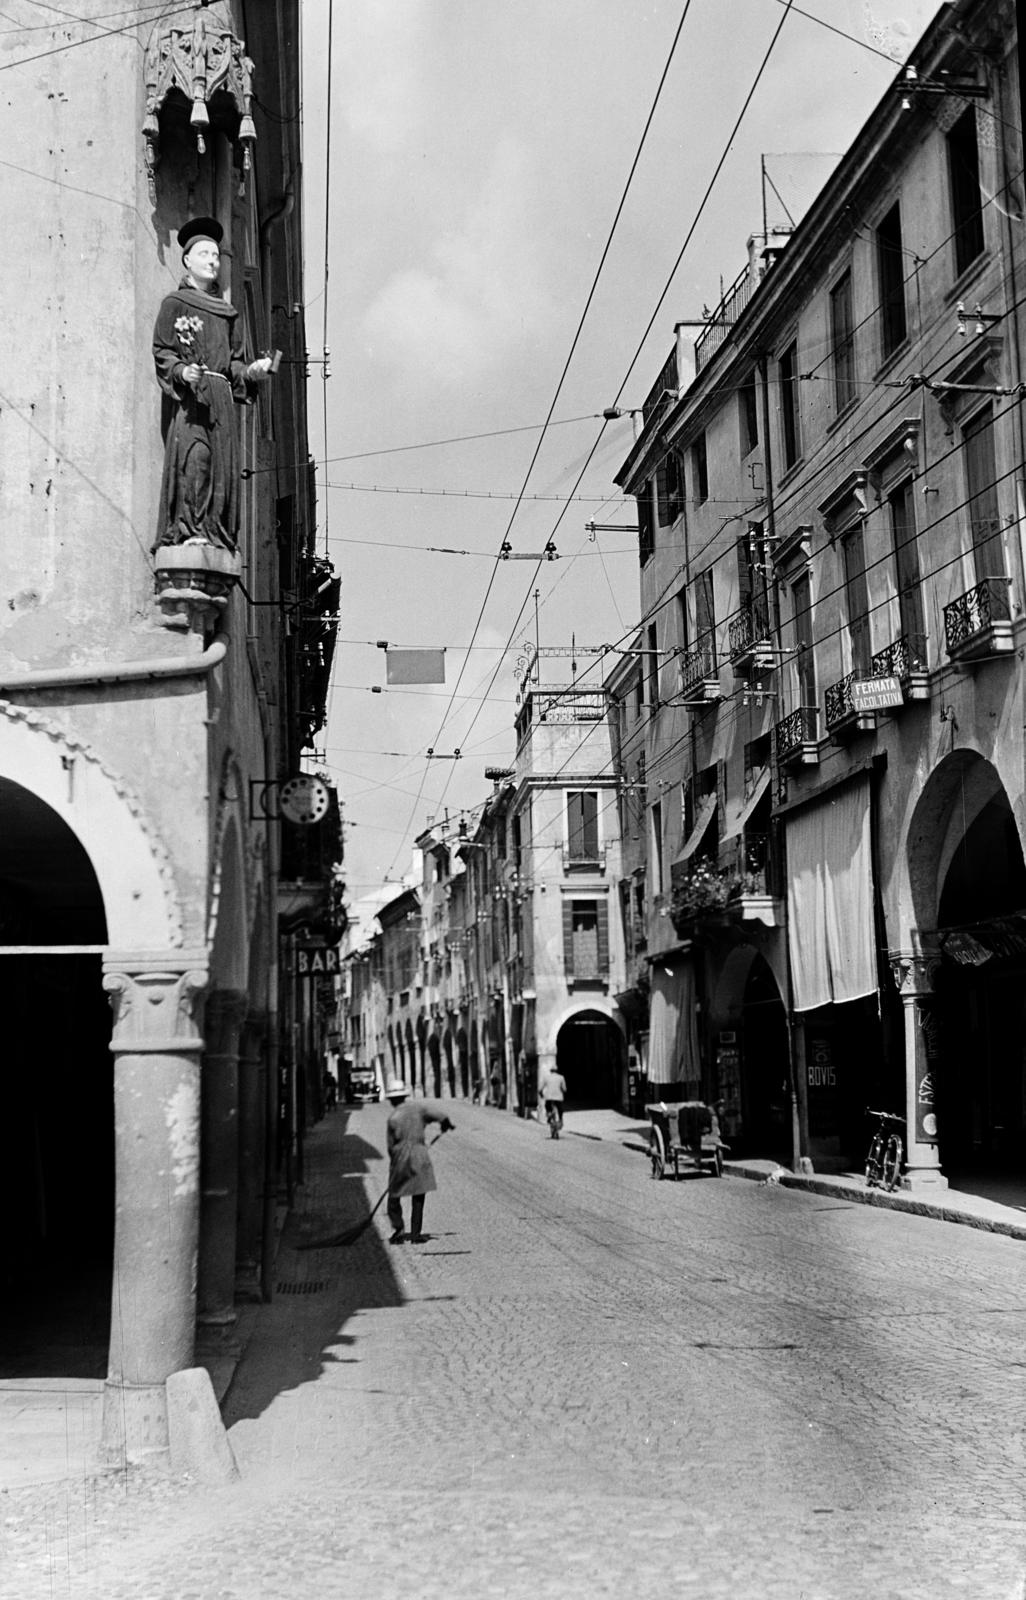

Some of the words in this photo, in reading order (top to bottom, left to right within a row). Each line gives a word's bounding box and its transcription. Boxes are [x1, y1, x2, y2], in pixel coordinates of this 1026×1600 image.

[855, 679, 896, 696] FERMATA
[298, 949, 336, 973] BAR
[808, 1066, 836, 1086] BOVIS
